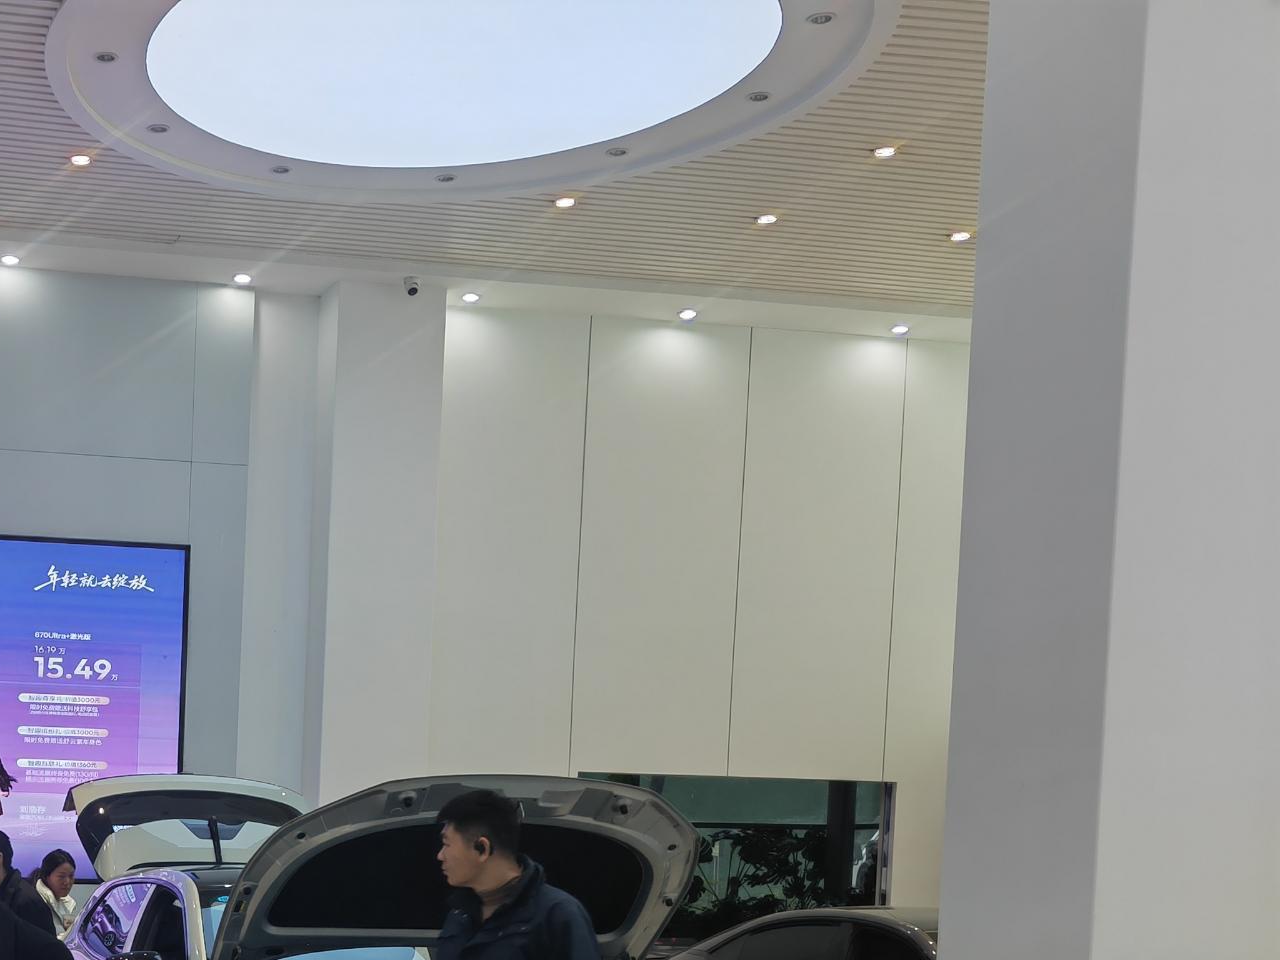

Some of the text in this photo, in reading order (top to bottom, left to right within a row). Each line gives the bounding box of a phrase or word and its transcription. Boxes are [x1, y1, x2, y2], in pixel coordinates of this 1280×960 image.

[33, 564, 155, 592] 年轻就去绽放
